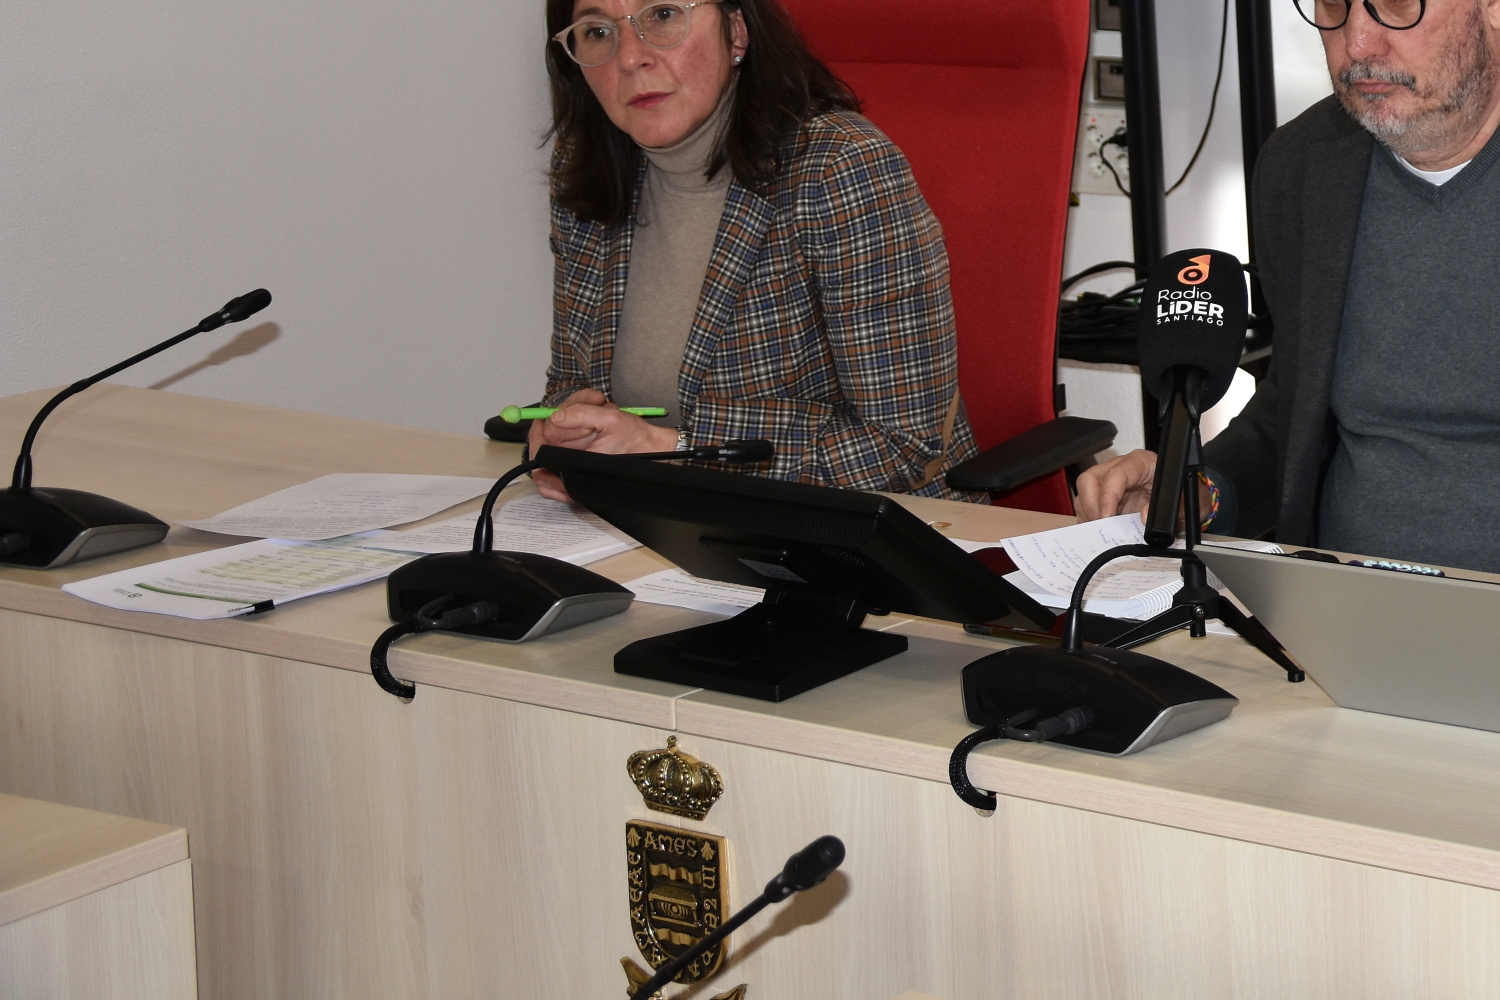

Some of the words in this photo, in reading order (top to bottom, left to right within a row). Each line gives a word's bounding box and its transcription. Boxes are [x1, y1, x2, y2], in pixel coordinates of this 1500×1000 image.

[1157, 286, 1212, 303] Radio
[1156, 315, 1224, 327] SANTIAGO
[1034, 671, 1089, 697] BOSCH
